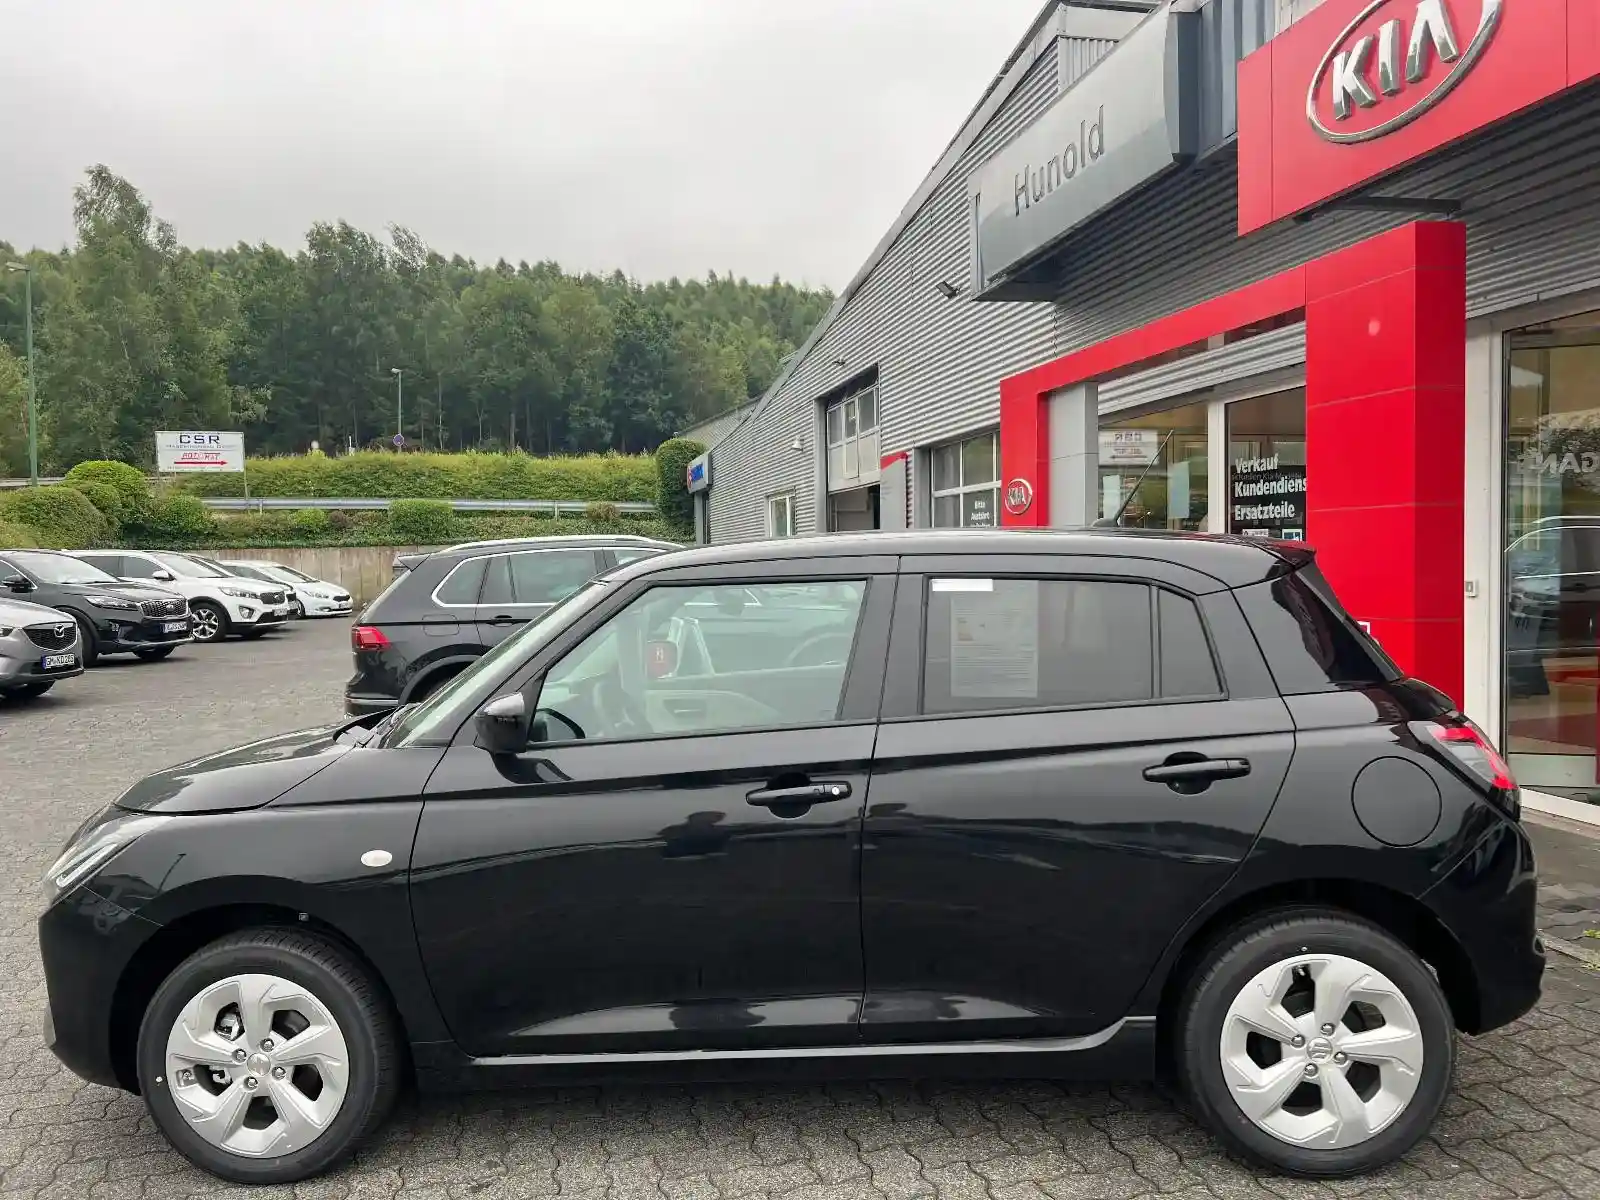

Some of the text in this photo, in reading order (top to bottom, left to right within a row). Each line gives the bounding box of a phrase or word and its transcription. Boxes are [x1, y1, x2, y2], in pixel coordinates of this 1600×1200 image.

[1332, 0, 1459, 121] KIA
[1014, 104, 1104, 217] Hunold
[179, 434, 220, 445] CSR
[1235, 453, 1279, 474] Verkauf
[1008, 486, 1026, 506] KIA
[1234, 501, 1296, 521] Ersatzteile
